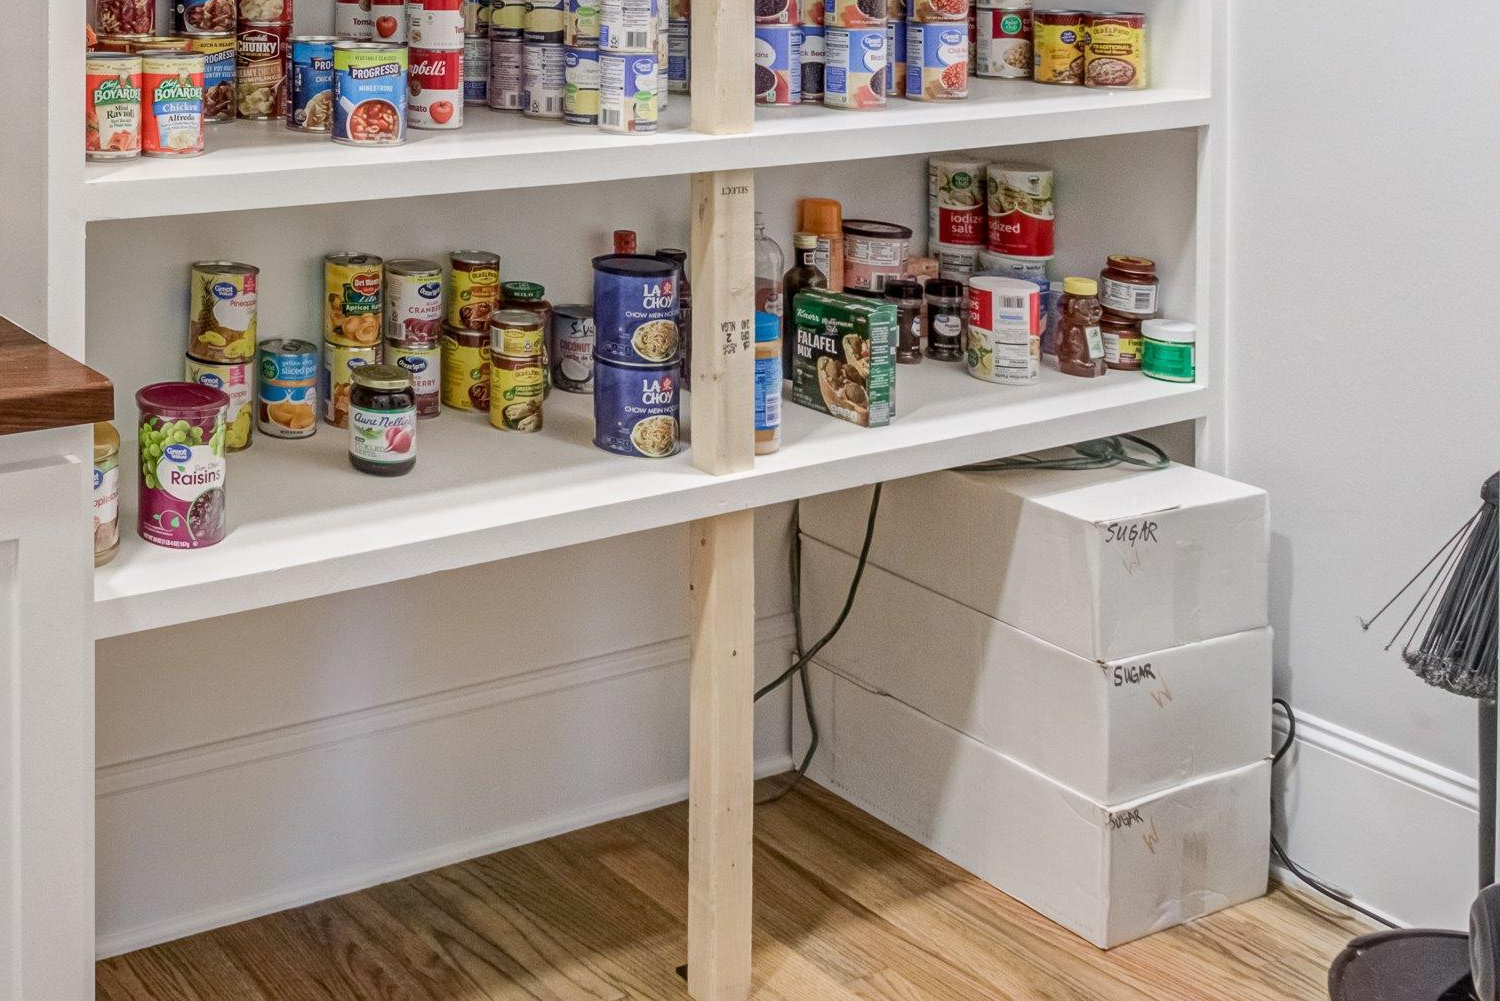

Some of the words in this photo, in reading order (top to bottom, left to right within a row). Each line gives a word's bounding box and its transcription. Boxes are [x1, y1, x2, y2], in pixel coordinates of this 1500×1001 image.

[238, 41, 277, 53] CHUNKY
[204, 50, 235, 63] ROGRESS
[353, 64, 399, 78] PROGRESSO
[100, 80, 117, 90] Chef
[160, 80, 177, 90] Chef
[94, 88, 142, 104] BOYARDE
[162, 102, 198, 112] Chicken
[107, 109, 135, 120] Ravioli
[168, 113, 195, 122] Alfredo
[721, 186, 749, 196] SELECT
[951, 213, 982, 223] iodize
[952, 224, 973, 234] salt
[643, 284, 660, 296] LA
[643, 295, 673, 309] CHOY
[797, 309, 820, 322] Knorr
[726, 333, 732, 343] 2
[797, 330, 838, 354] FALAFEL
[560, 340, 590, 352] COCONUT
[797, 344, 812, 358] MIX
[412, 379, 435, 387] BERRY
[642, 379, 660, 392] LA
[642, 391, 673, 404] CHOY
[354, 413, 377, 426] Aunt
[167, 447, 188, 455] Great
[171, 469, 221, 486] Raisins
[1106, 521, 1158, 548] SUGAR
[1113, 663, 1156, 687] SUGAR
[1109, 809, 1144, 830] SUGAR
